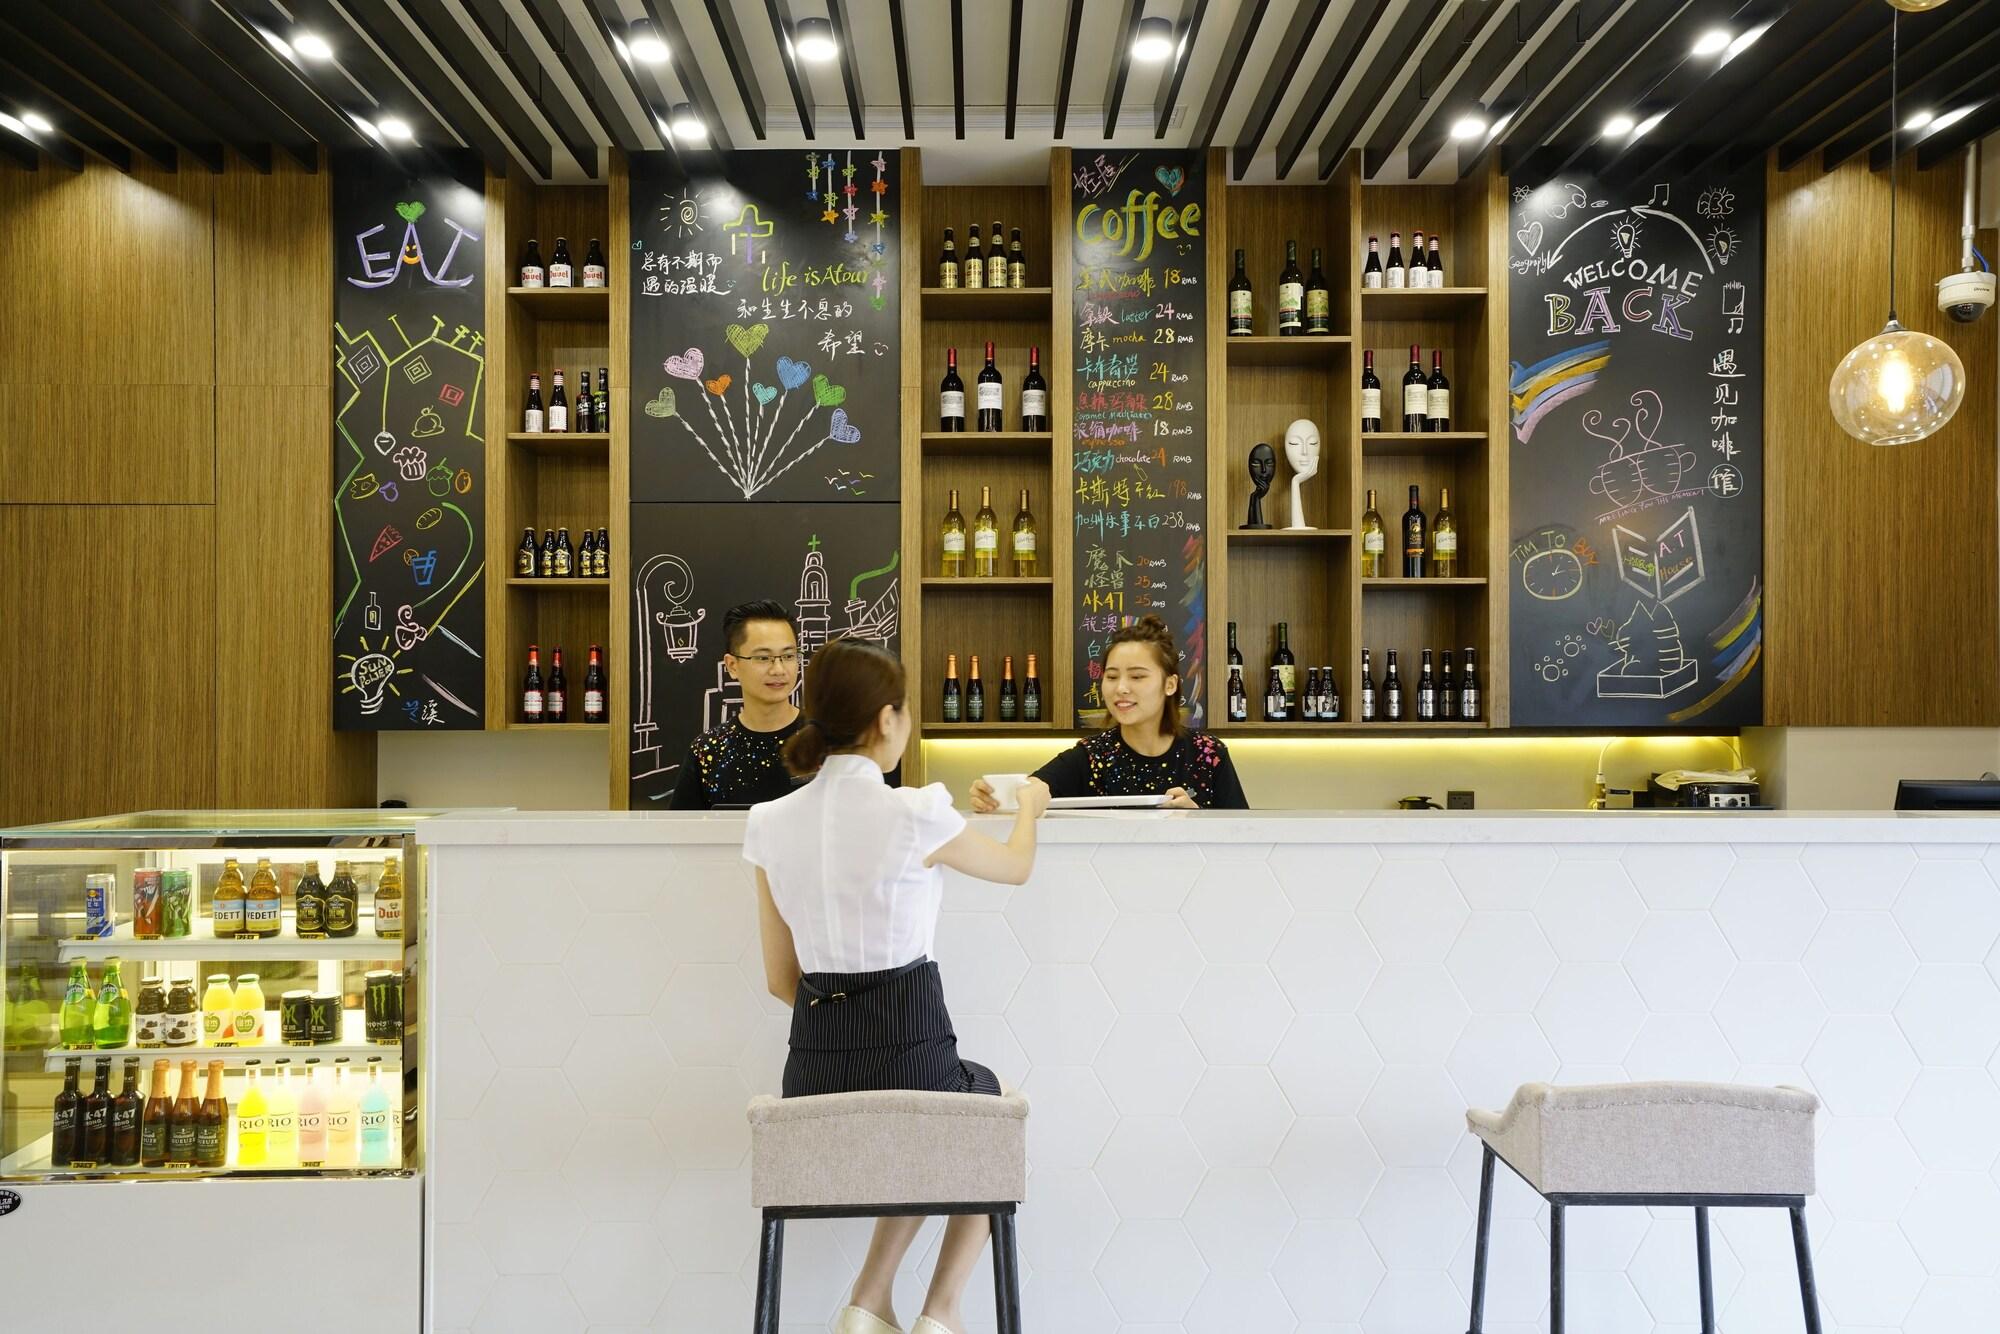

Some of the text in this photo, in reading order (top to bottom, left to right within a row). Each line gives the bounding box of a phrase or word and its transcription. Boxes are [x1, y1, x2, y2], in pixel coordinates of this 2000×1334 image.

[347, 217, 481, 289] EAT
[641, 250, 722, 275] 总有不期而
[641, 274, 732, 296] 遇的温暖
[1163, 268, 1182, 289] 18
[1181, 276, 1198, 286] RMB
[1563, 258, 1704, 297] WELCOME
[737, 297, 853, 320] 和生生不息的
[1155, 302, 1175, 320] 24
[1176, 312, 1194, 321] RMB
[1544, 287, 1696, 342] BACK
[818, 329, 865, 361] 希望
[1080, 328, 1194, 353] 摩卡 mocha 28 RMB
[1150, 362, 1170, 384] 24
[1152, 392, 1174, 411] 28
[1175, 402, 1193, 411] RMB
[1154, 420, 1170, 436] 18
[1172, 426, 1193, 436] RMB
[1708, 349, 1746, 495] 遇见咖啡馆
[1115, 450, 1151, 464] chocolate
[1173, 455, 1192, 464] RMB
[1187, 492, 1202, 500] RMB
[1162, 511, 1185, 528] 238
[1185, 522, 1201, 532] RMB
[1149, 559, 1167, 568] RMB
[1084, 569, 1167, 590] 怪兽 25 RMB
[1083, 590, 1124, 613] AK47
[1151, 600, 1166, 608] RMB
[214, 911, 241, 921] EDETT
[239, 1118, 265, 1129] RIO
[268, 1117, 291, 1128] RIO
[361, 1114, 385, 1125] RIO
